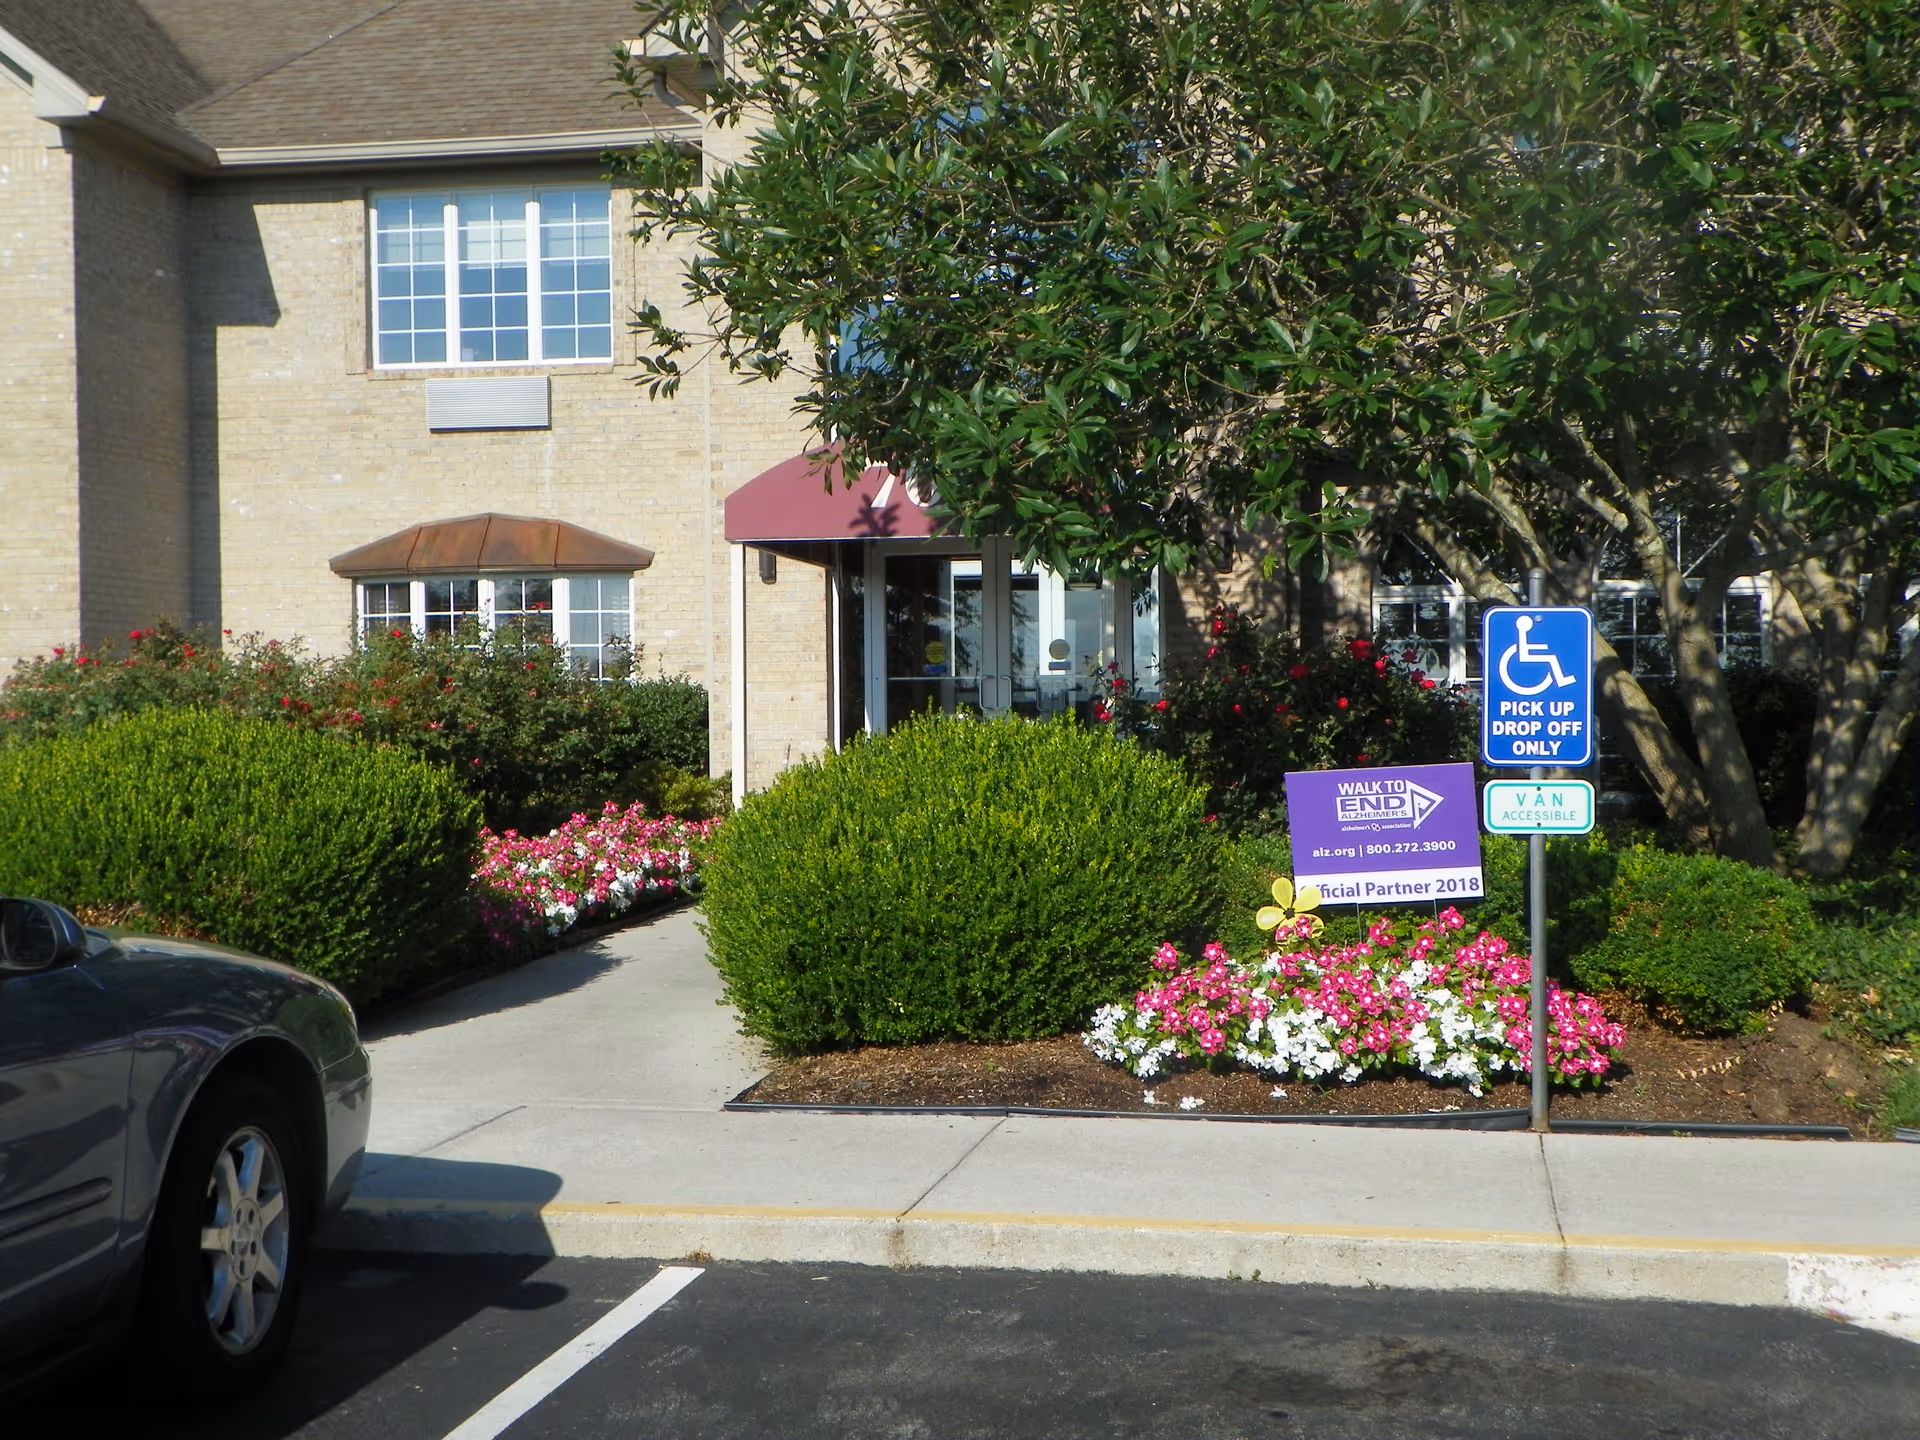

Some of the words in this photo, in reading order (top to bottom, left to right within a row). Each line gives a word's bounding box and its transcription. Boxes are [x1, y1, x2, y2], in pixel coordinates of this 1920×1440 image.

[1500, 701, 1544, 716] PICK
[1549, 701, 1575, 716] UP
[1492, 721, 1542, 736] DROP
[1547, 721, 1583, 736] OFF
[1512, 740, 1562, 756] ONLY
[1337, 780, 1382, 795] WALK
[1384, 779, 1405, 793] TO
[1340, 796, 1406, 812] END
[1516, 793, 1563, 807] VAN
[1340, 809, 1407, 820] ALZHEIMER'S
[1502, 810, 1577, 821] ACCESSIBLE
[1312, 846, 1356, 858] alz.org
[1366, 840, 1456, 855] 800.272.3900
[1300, 882, 1361, 899] ficial
[1365, 881, 1431, 897] Partner
[1435, 877, 1480, 893] 2018
